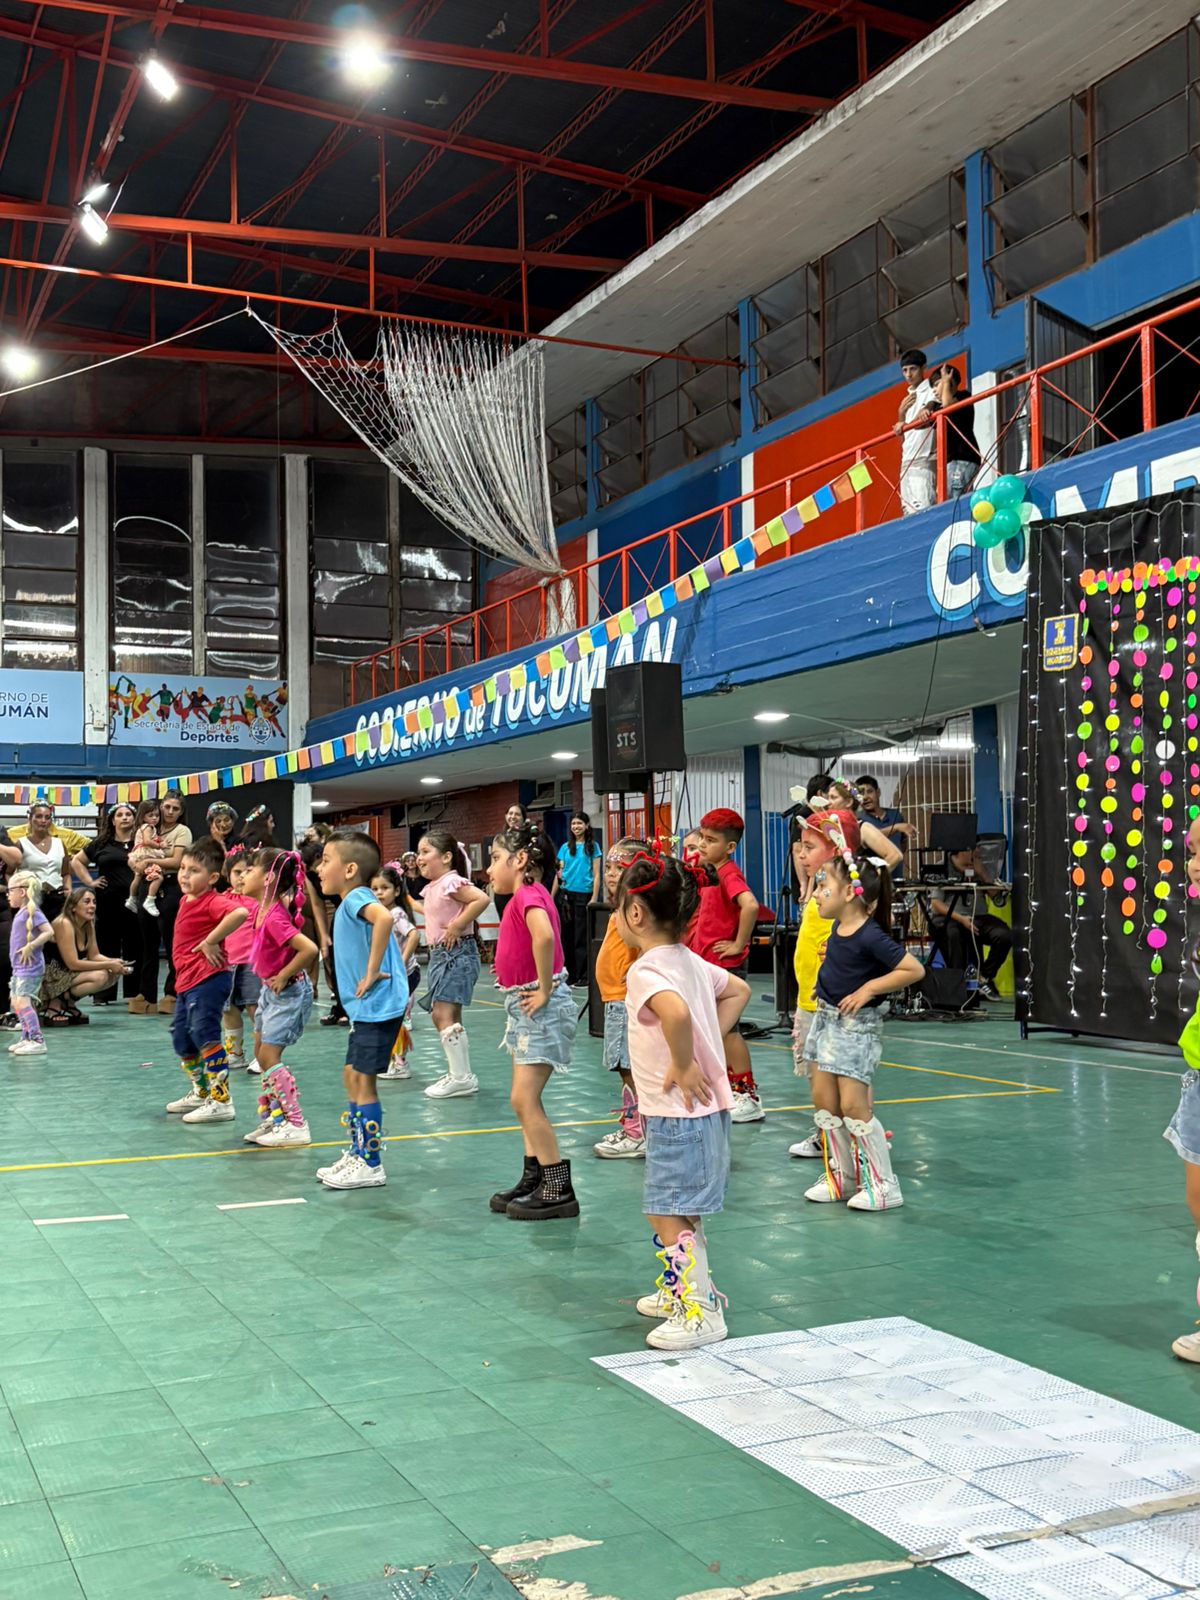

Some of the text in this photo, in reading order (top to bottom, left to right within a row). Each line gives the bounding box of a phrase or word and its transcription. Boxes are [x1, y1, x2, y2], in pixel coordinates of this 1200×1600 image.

[31, 693, 48, 703] DE
[183, 721, 194, 731] de
[196, 722, 227, 732] Estado
[229, 722, 241, 732] de
[180, 731, 240, 744] Deportes
[616, 731, 637, 748] STS
